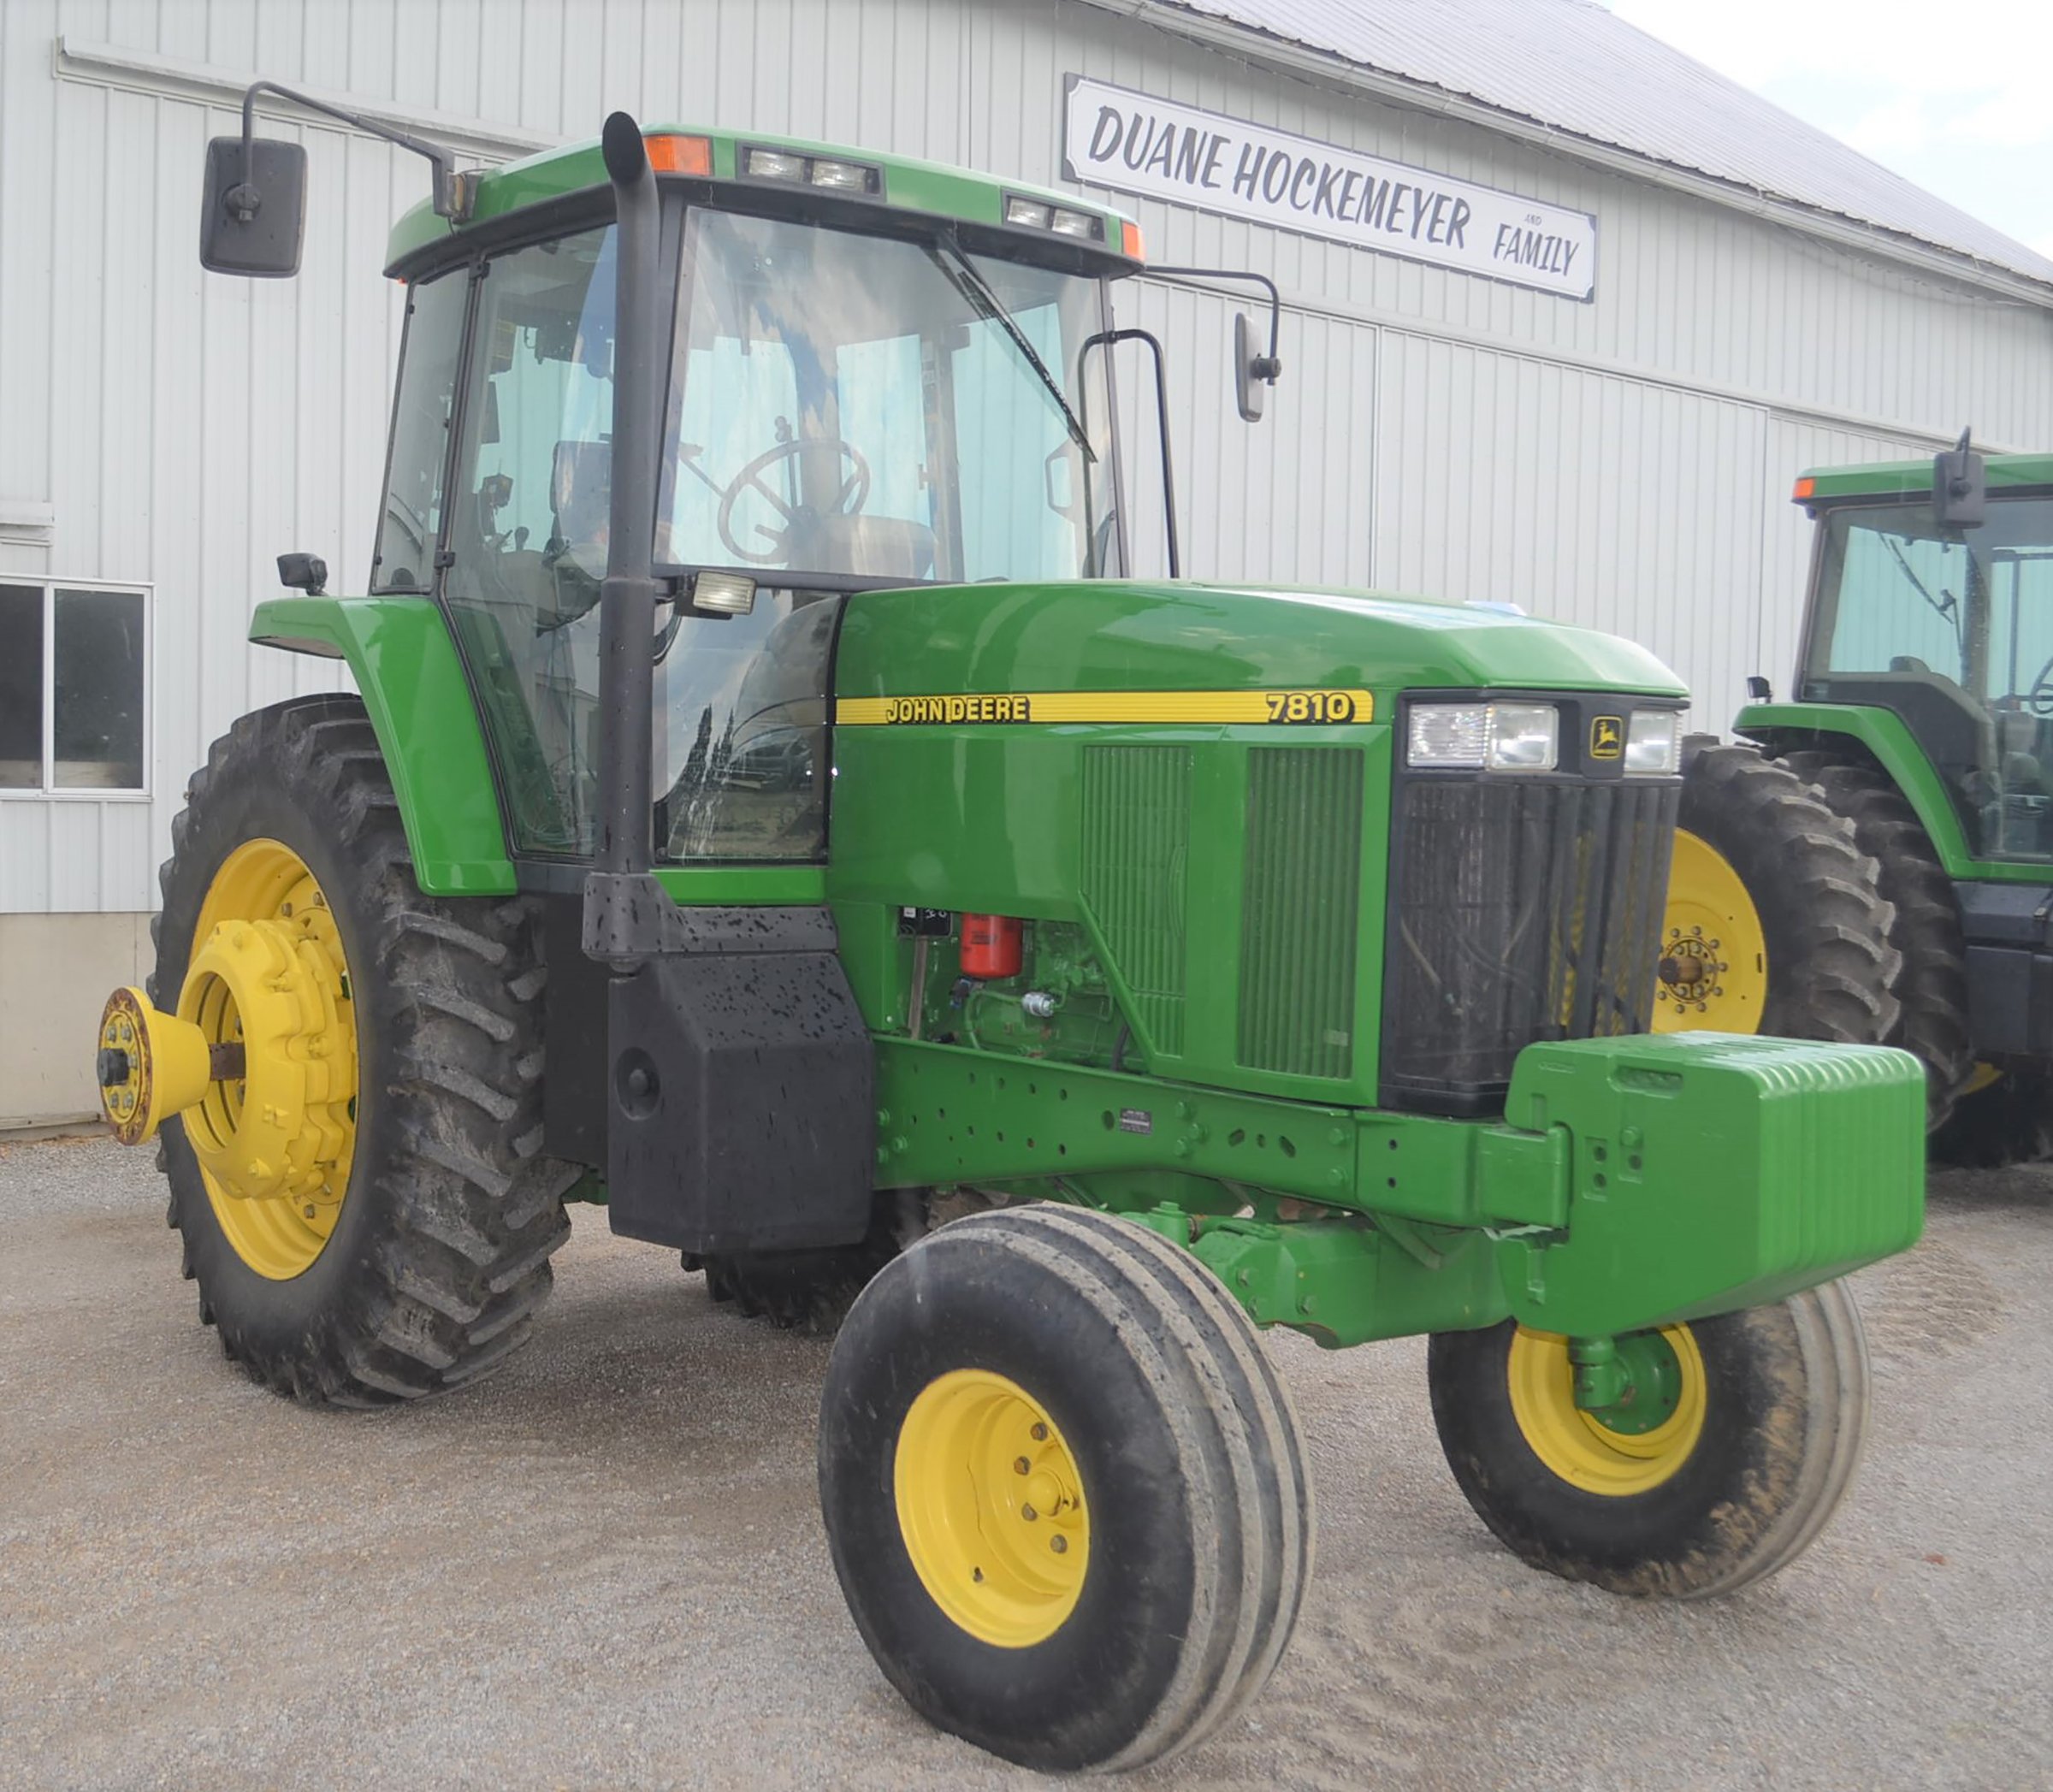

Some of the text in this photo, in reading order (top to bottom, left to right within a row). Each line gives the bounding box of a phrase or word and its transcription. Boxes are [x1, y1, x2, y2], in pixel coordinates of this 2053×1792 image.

[1089, 105, 1470, 249] DUANE HOCKEMEYER
[1494, 222, 1579, 276] FAMILY
[886, 696, 1031, 724] JOHN DEERE
[1266, 692, 1356, 724] 7810
